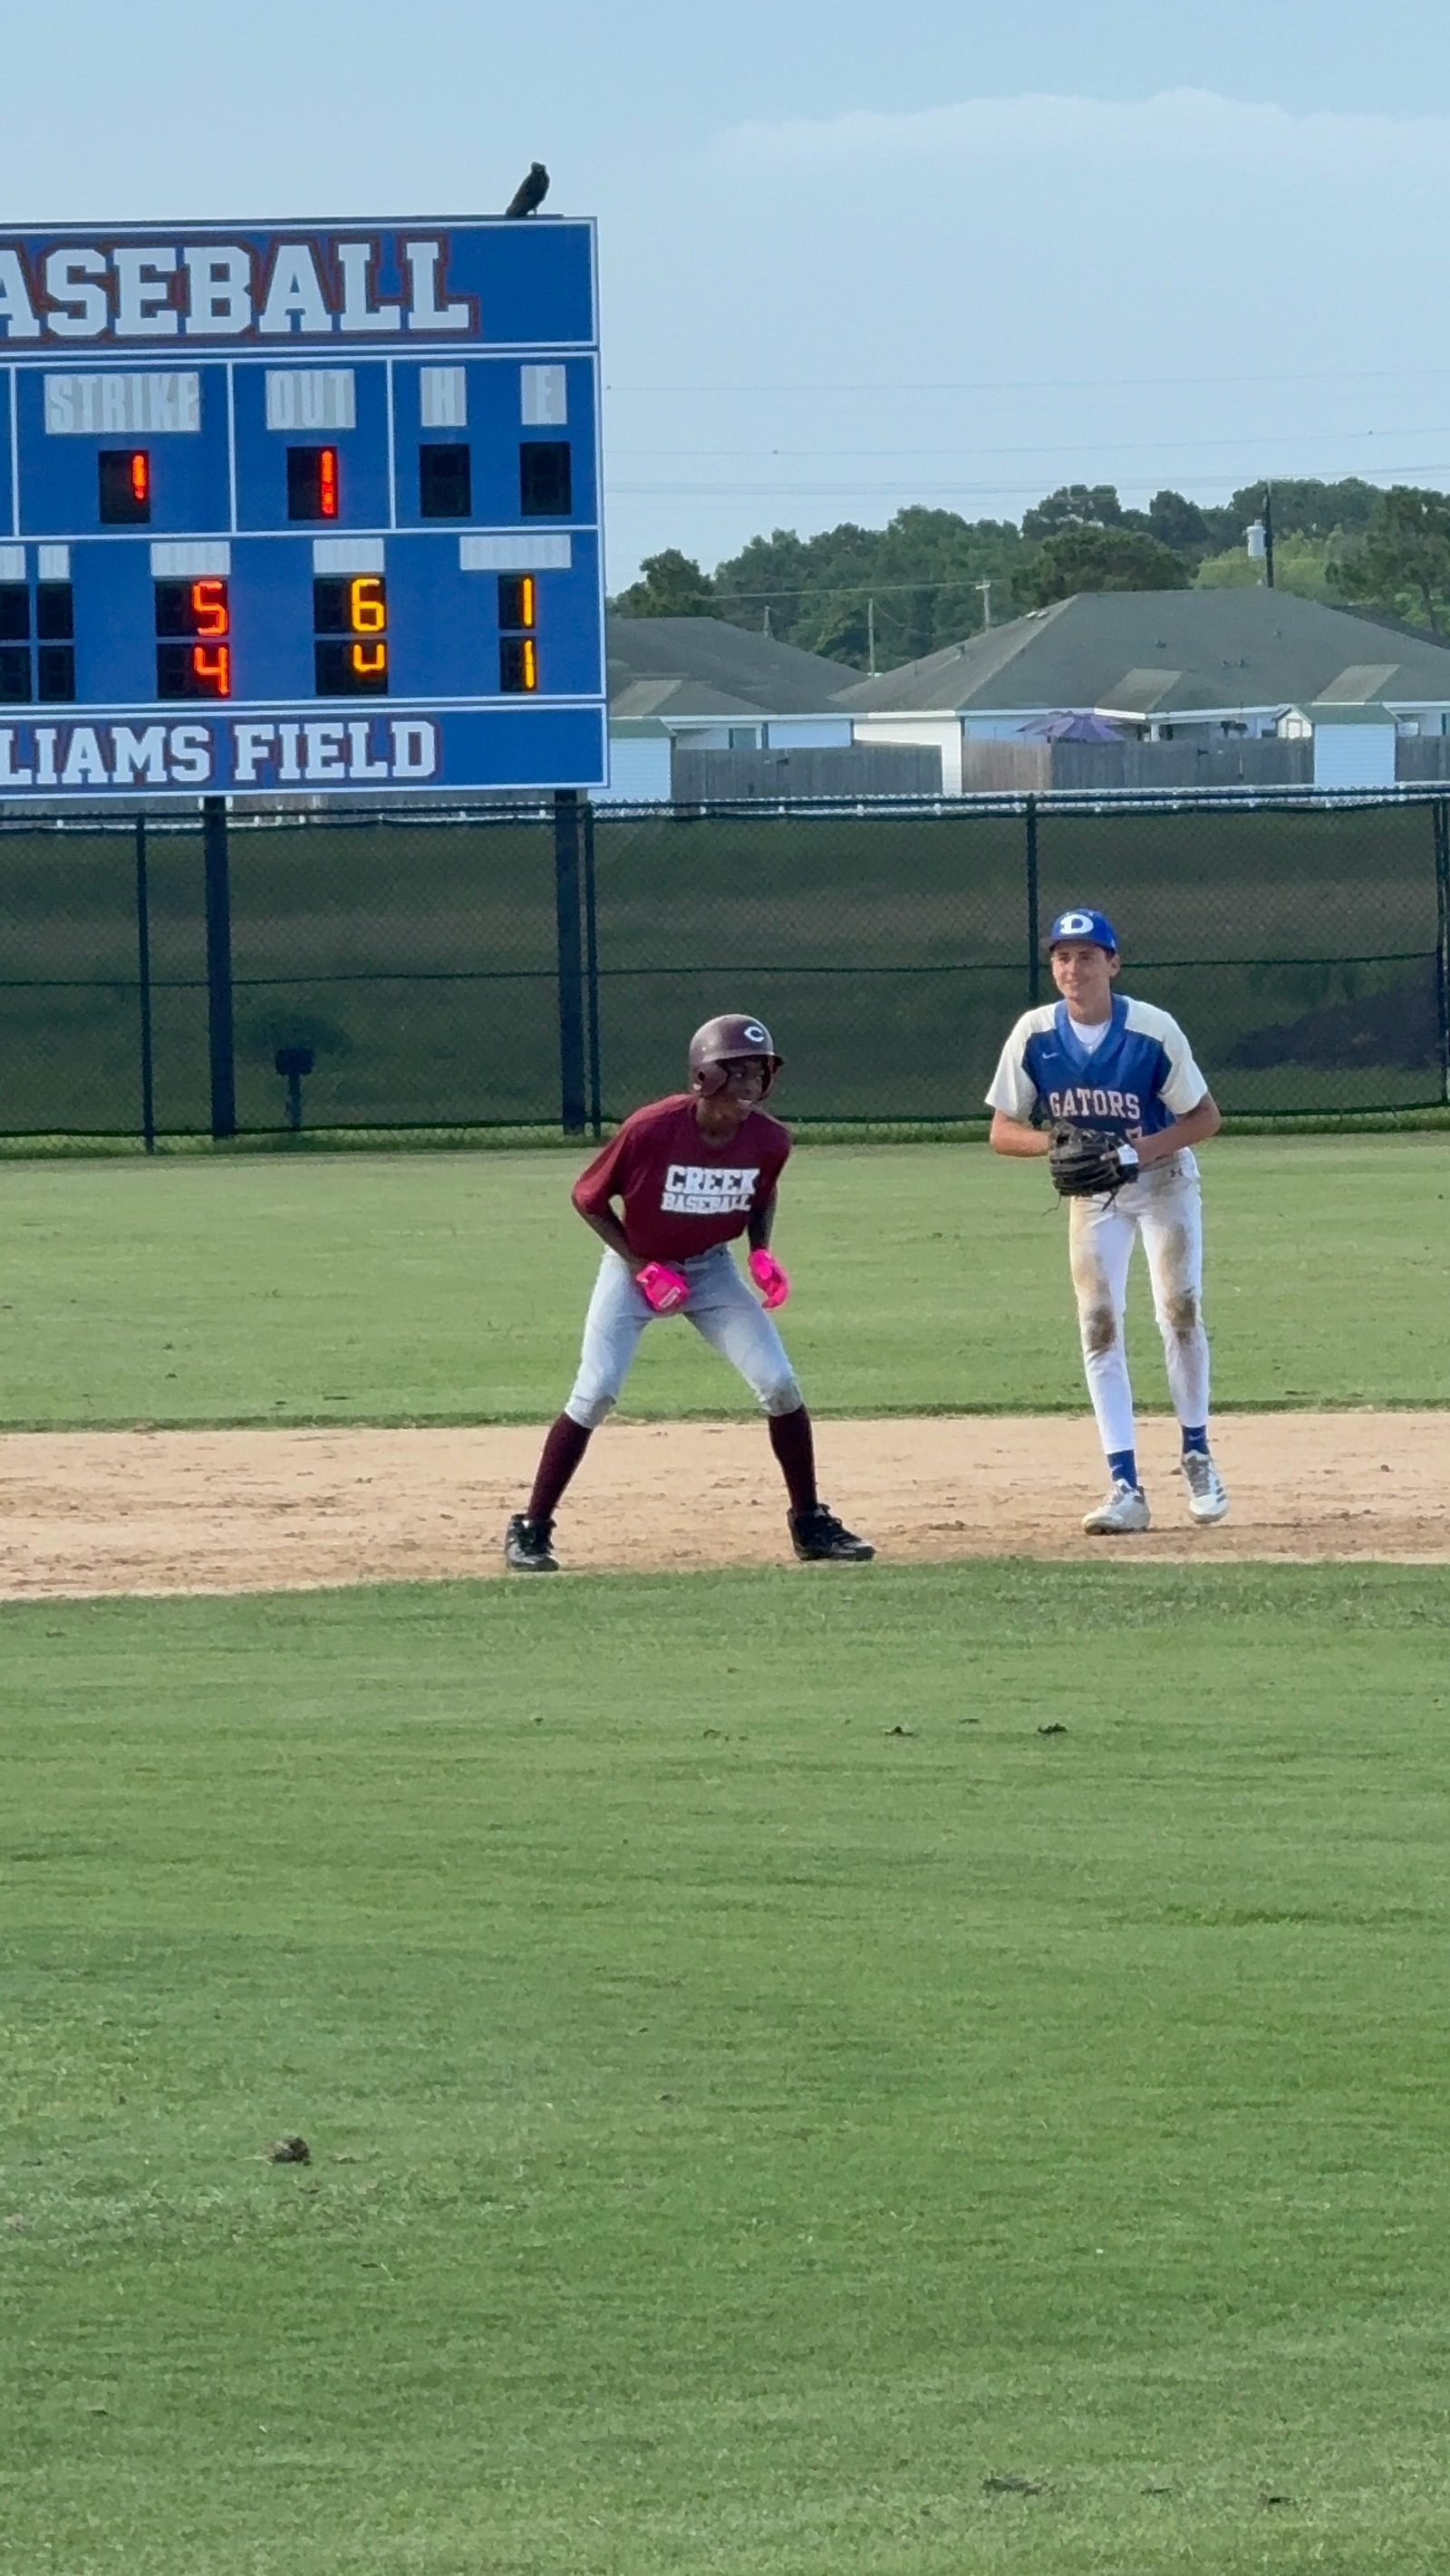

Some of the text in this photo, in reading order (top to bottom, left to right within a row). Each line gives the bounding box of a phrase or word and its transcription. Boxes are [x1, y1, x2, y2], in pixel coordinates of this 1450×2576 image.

[47, 373, 197, 431] STRIKE
[271, 371, 352, 428] OUT
[431, 368, 459, 426] H
[132, 455, 146, 499] 1
[322, 451, 334, 514] 1
[192, 581, 227, 636] 5
[351, 578, 385, 632] 6
[522, 578, 533, 626] 1
[194, 646, 230, 695] 4
[523, 640, 535, 689] 1
[234, 721, 435, 780] FIELD
[1060, 913, 1094, 935] D
[744, 1026, 764, 1042] C
[1049, 1088, 1141, 1120] GATORS
[661, 1192, 751, 1214] BASEBALL
[665, 1164, 759, 1196] CREEK
